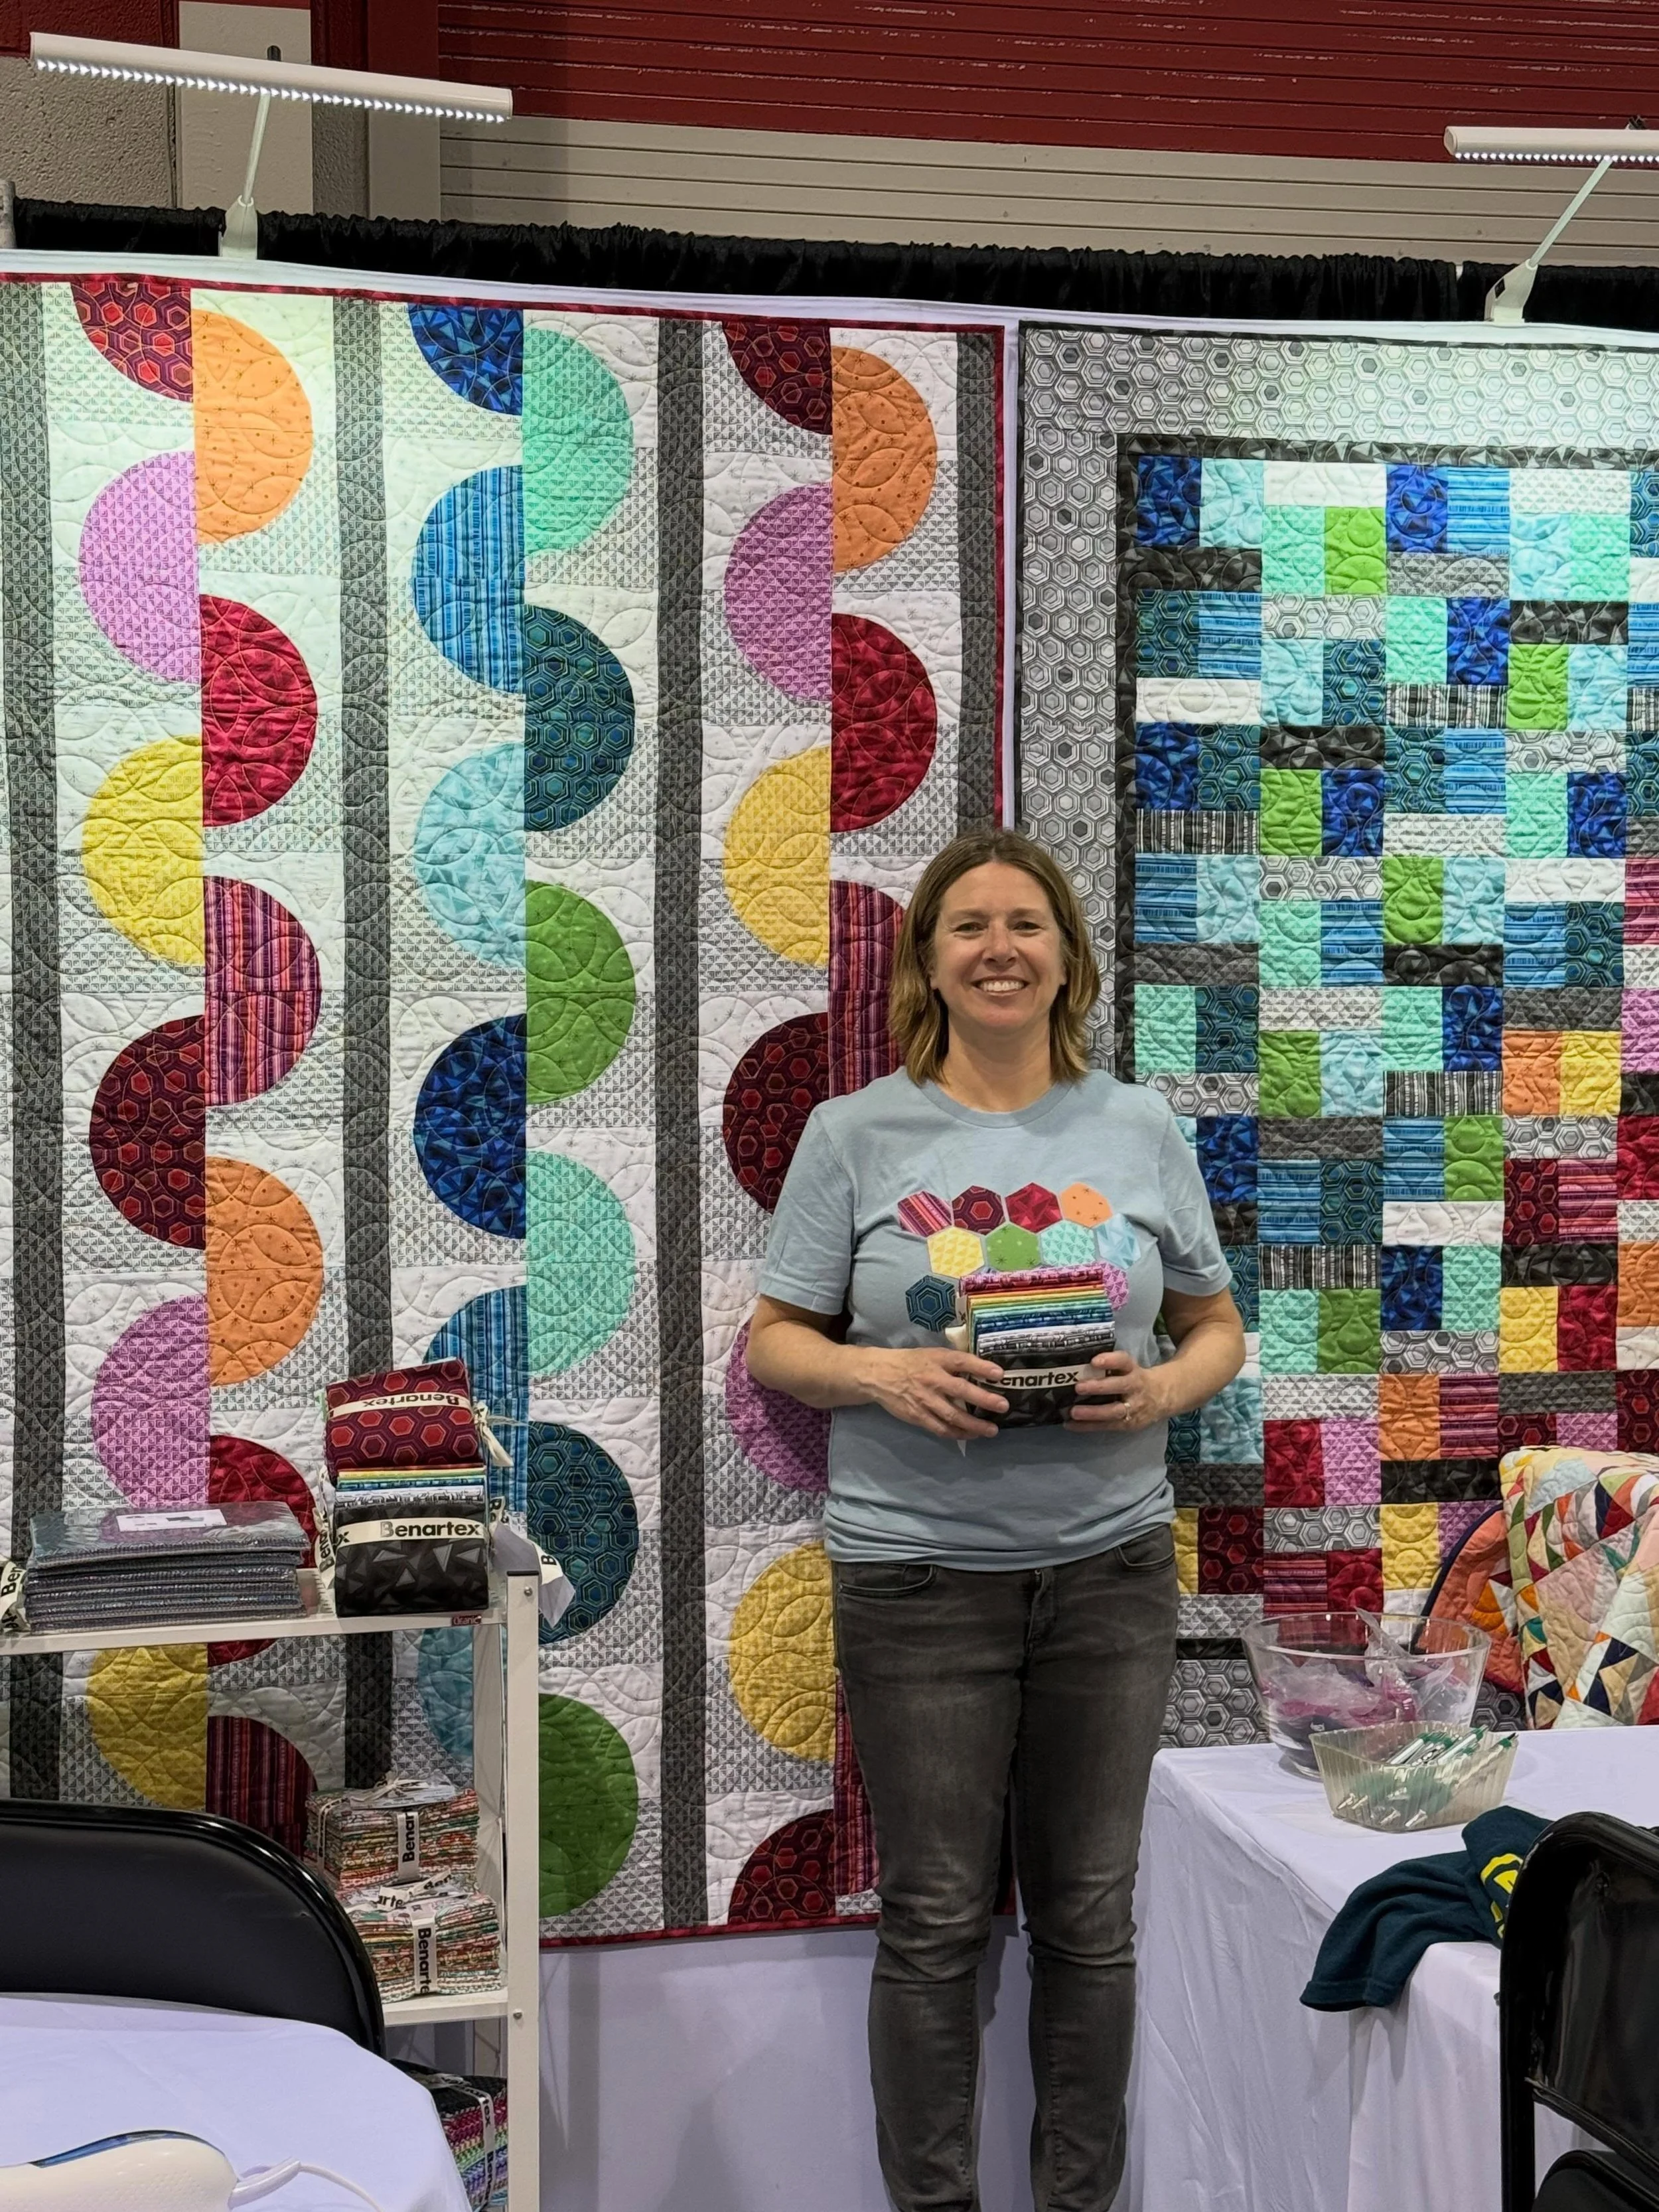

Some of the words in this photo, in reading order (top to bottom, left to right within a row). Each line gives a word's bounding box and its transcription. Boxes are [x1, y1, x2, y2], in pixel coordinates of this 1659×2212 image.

[986, 1371, 1079, 1387] enartex
[362, 1394, 460, 1407] Benartex
[380, 1521, 481, 1537] Benartex
[418, 1928, 431, 1994] Benarte
